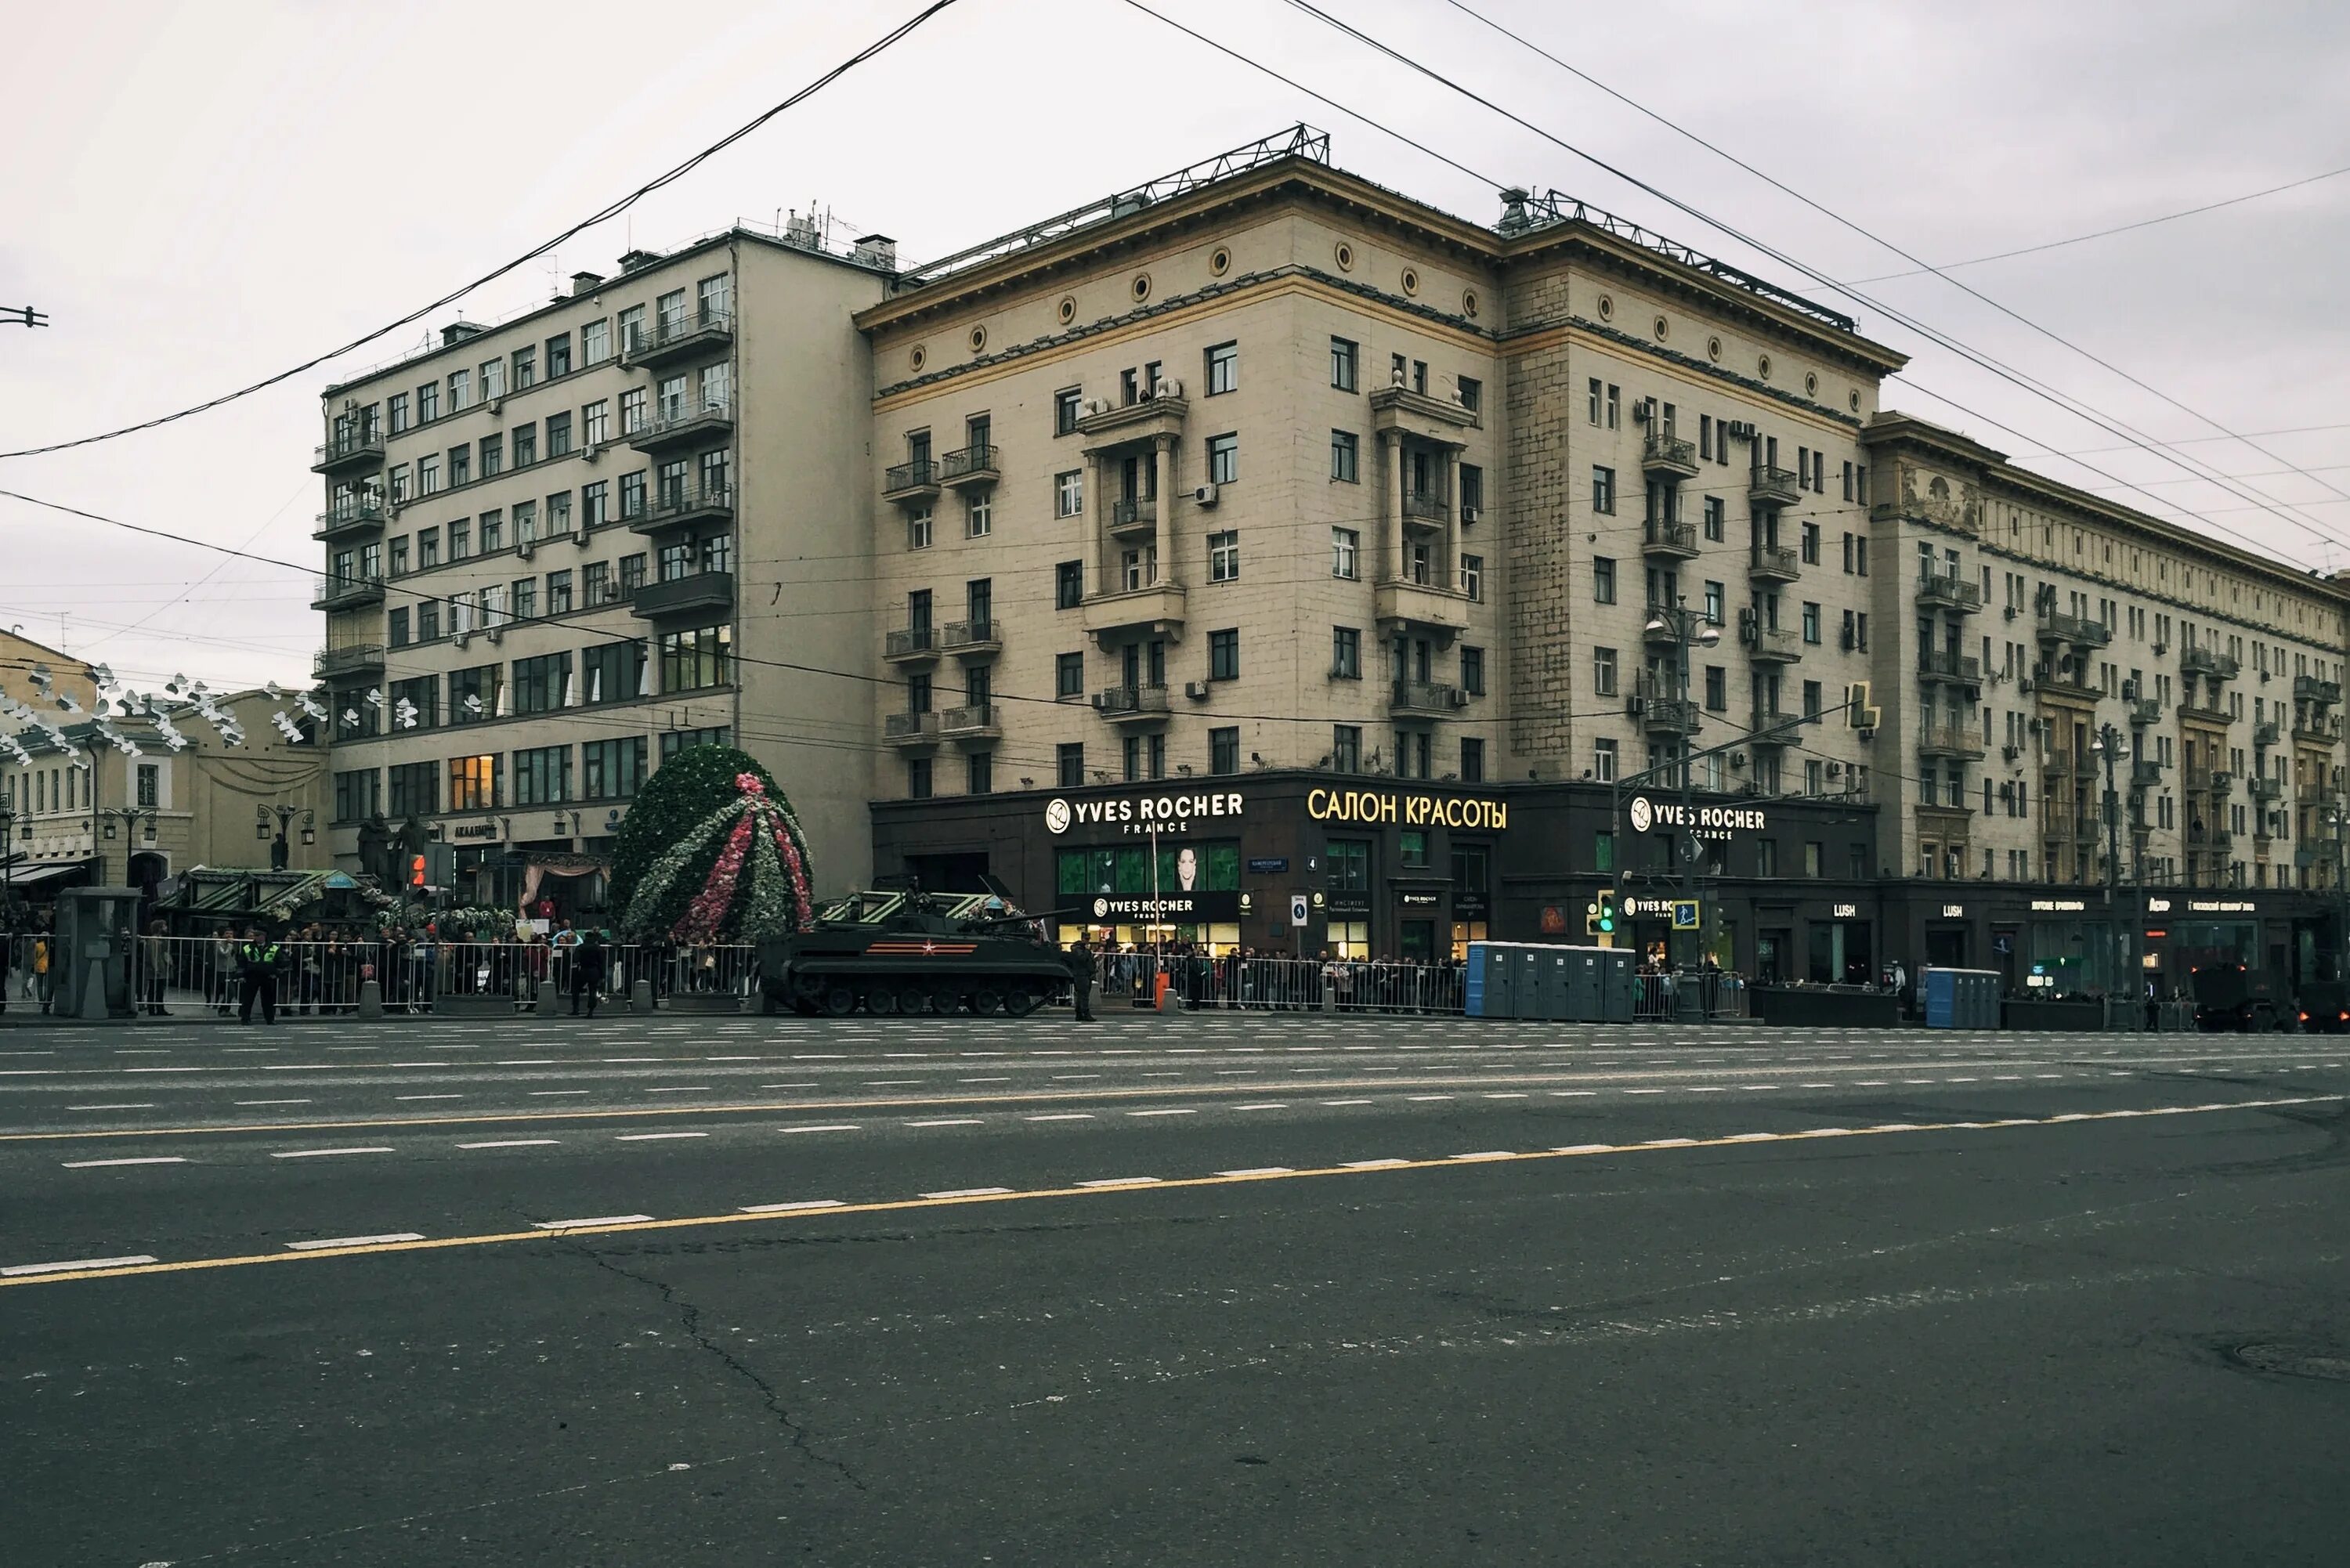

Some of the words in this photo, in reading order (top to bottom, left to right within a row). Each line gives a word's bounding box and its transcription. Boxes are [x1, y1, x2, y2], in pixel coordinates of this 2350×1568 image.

[1075, 800, 1132, 822] YVES
[1141, 793, 1243, 819] ROCHER
[1307, 789, 1396, 822] САЛОН
[1405, 796, 1506, 829] КРАСОТЫ
[1701, 808, 1765, 829] ROCHER
[1124, 822, 1187, 833] FRANCE
[1310, 858, 1315, 869] 4
[1109, 901, 1139, 912] YVES
[1142, 899, 1193, 912] ROCHER
[1637, 901, 1660, 912] YVES
[1834, 905, 1856, 917] LUSH
[1943, 905, 1963, 917] LUSH
